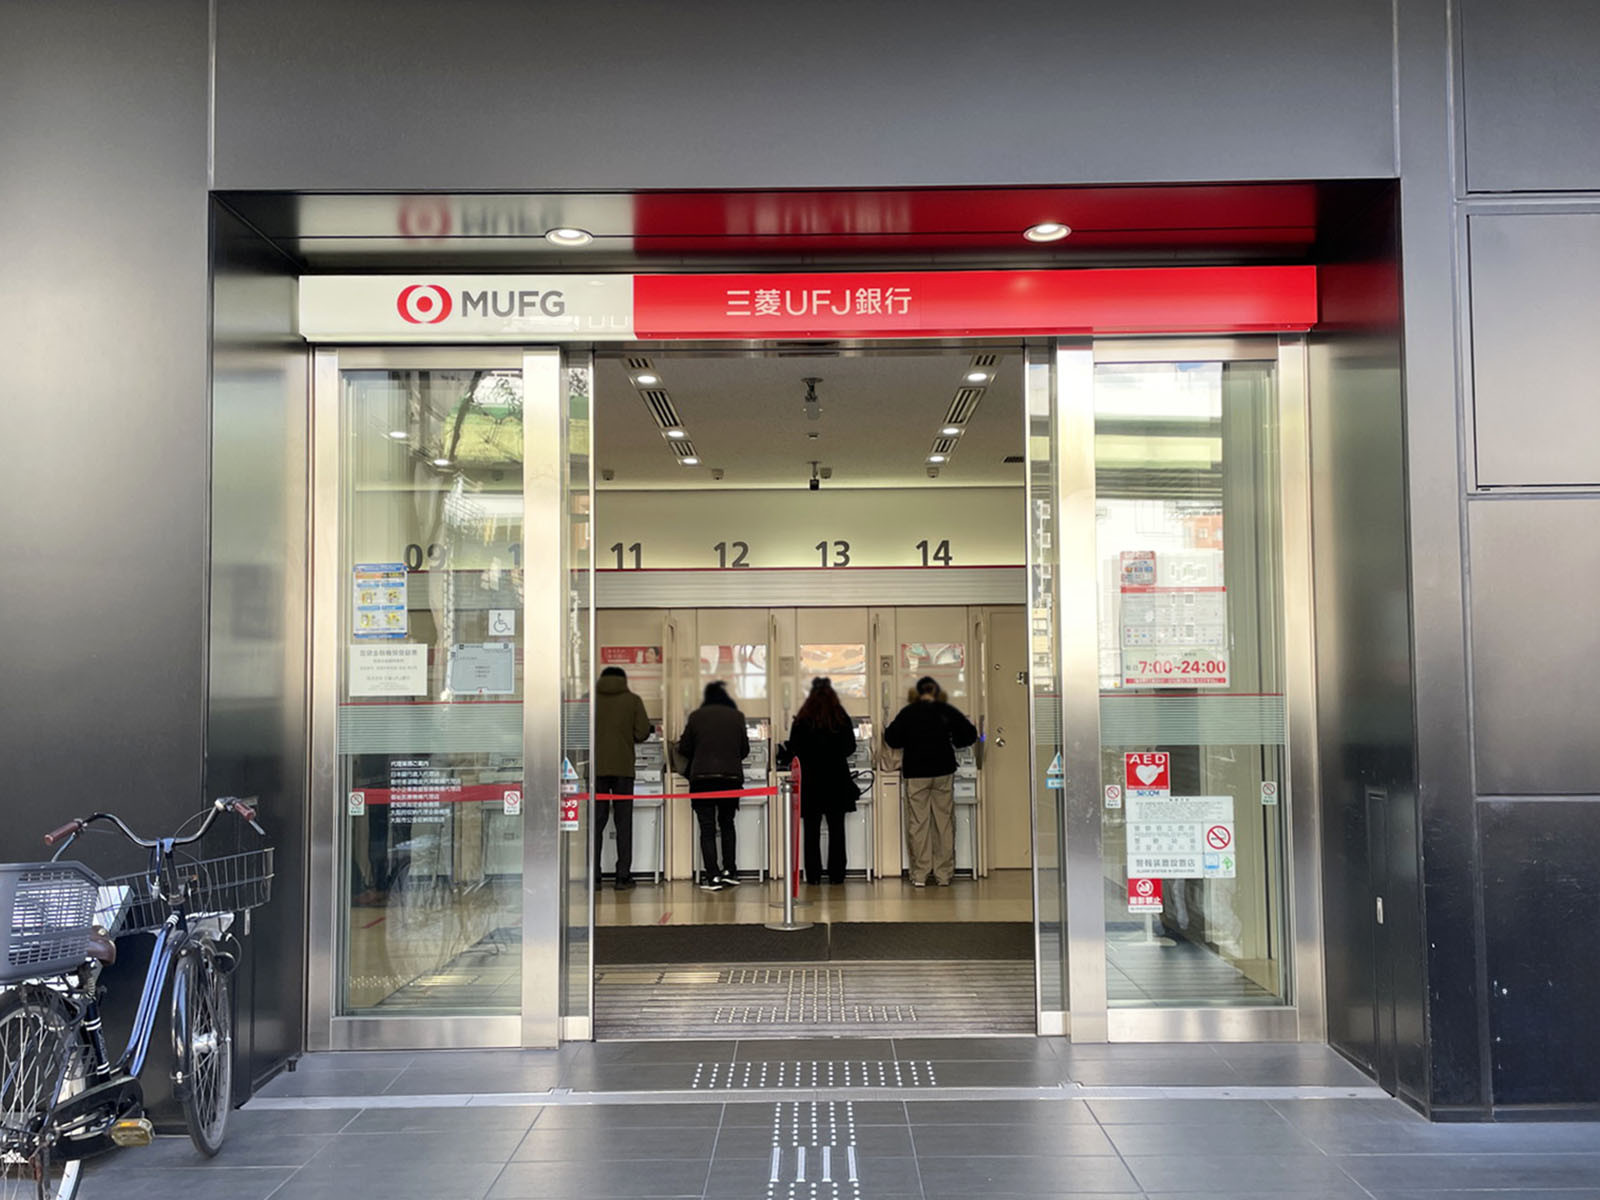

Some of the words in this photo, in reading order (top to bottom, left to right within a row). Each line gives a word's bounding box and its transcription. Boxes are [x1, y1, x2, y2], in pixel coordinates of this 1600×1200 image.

[461, 290, 566, 318] MUFG
[726, 287, 912, 317] 三菱UFJ銀行
[404, 543, 447, 571] 09
[610, 542, 642, 569] 11
[713, 541, 750, 568] 12
[815, 540, 851, 568] 13
[916, 539, 953, 567] 14
[1129, 754, 1166, 765] AED
